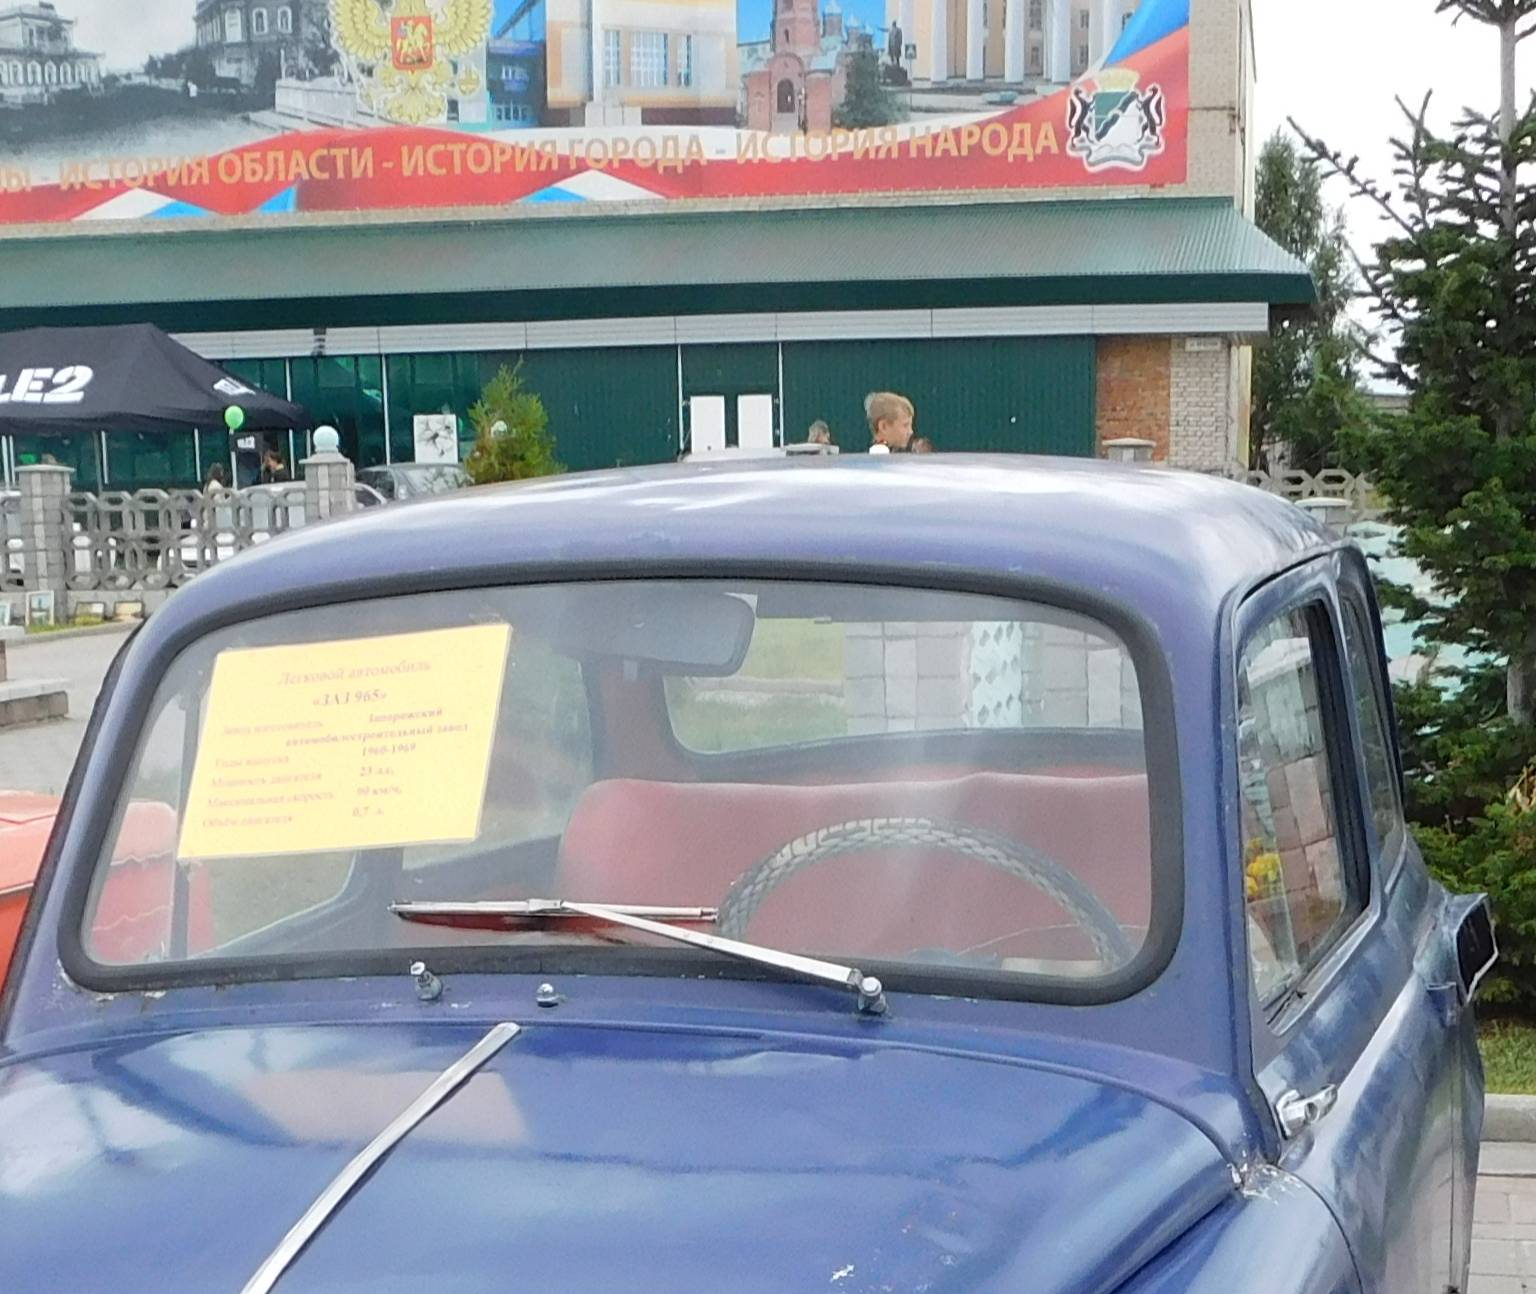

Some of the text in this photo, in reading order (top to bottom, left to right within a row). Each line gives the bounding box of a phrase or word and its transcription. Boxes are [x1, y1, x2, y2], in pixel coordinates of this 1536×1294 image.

[59, 155, 209, 190] ИСТОРИЯ
[218, 146, 373, 184] ОБЛАСТИ
[401, 139, 558, 176] ИСТОРИЯ
[568, 133, 708, 174] ГОРОДА
[736, 125, 899, 164] ИСТОРИЯ
[910, 120, 1059, 162] НАРОДА
[276, 658, 432, 687] Легковой автомобиль
